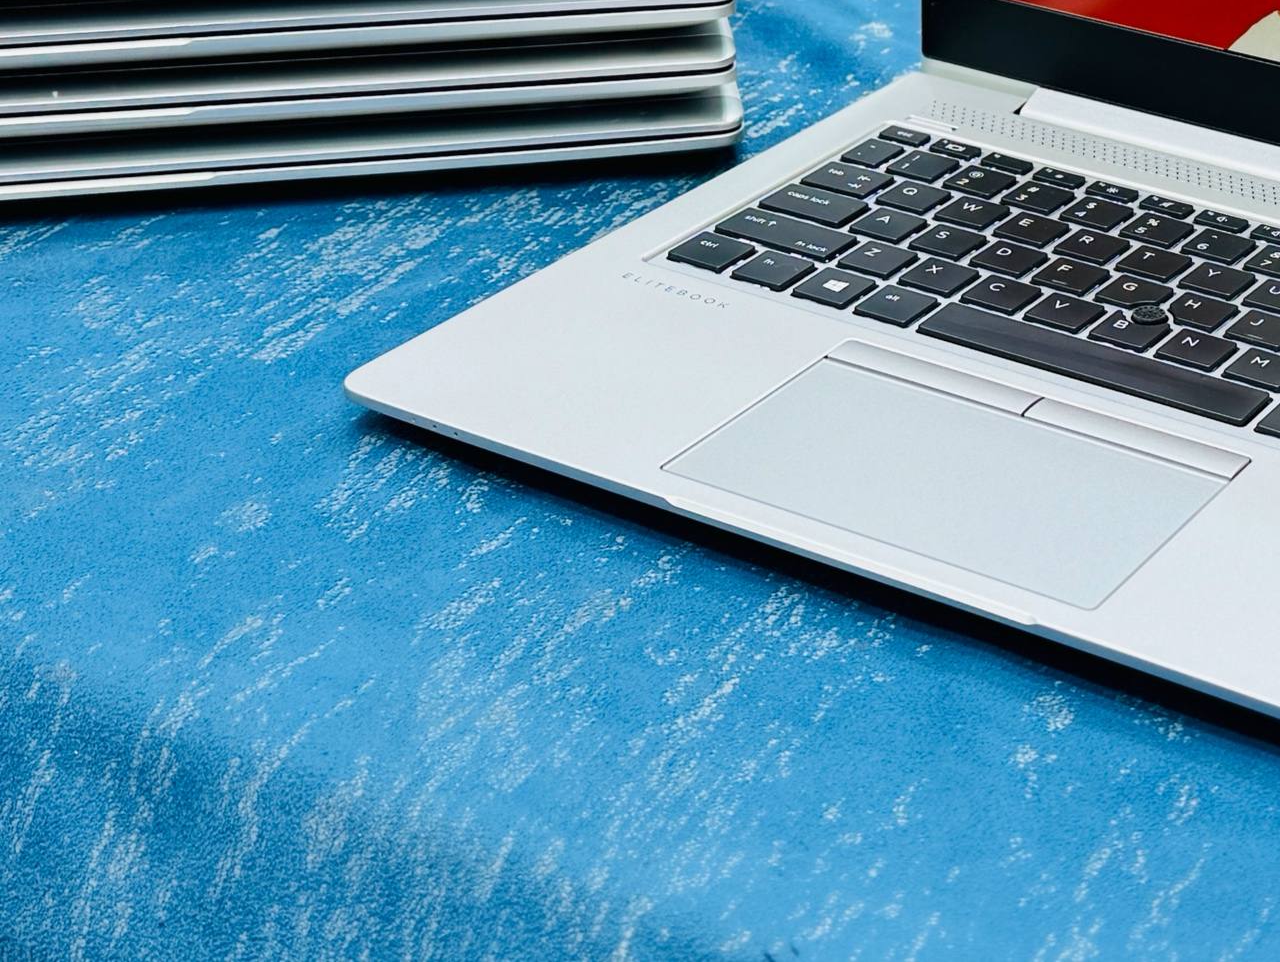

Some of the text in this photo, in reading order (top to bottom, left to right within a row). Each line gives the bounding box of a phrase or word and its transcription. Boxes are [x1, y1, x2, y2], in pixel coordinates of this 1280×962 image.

[902, 187, 918, 196] Q
[809, 196, 830, 207] lock
[962, 202, 983, 212] W
[744, 214, 767, 226] shift
[875, 215, 891, 224] A
[1018, 218, 1034, 227] E
[935, 230, 950, 239] S
[1078, 235, 1095, 244] R
[700, 240, 720, 248] ctrl
[806, 243, 828, 253] lock
[863, 247, 882, 257] Z
[996, 247, 1012, 256] D
[1143, 251, 1156, 260] T
[925, 264, 944, 274] X
[1056, 264, 1073, 272] F
[1208, 268, 1222, 277] Y
[621, 271, 730, 308] ELITEBOOK
[989, 282, 1006, 292] C
[1122, 282, 1139, 291] G
[1055, 299, 1070, 309] V
[1184, 299, 1202, 309] H
[1112, 319, 1129, 329] B
[1249, 318, 1265, 326] J
[1181, 336, 1200, 347] N
[1250, 356, 1270, 368] M
